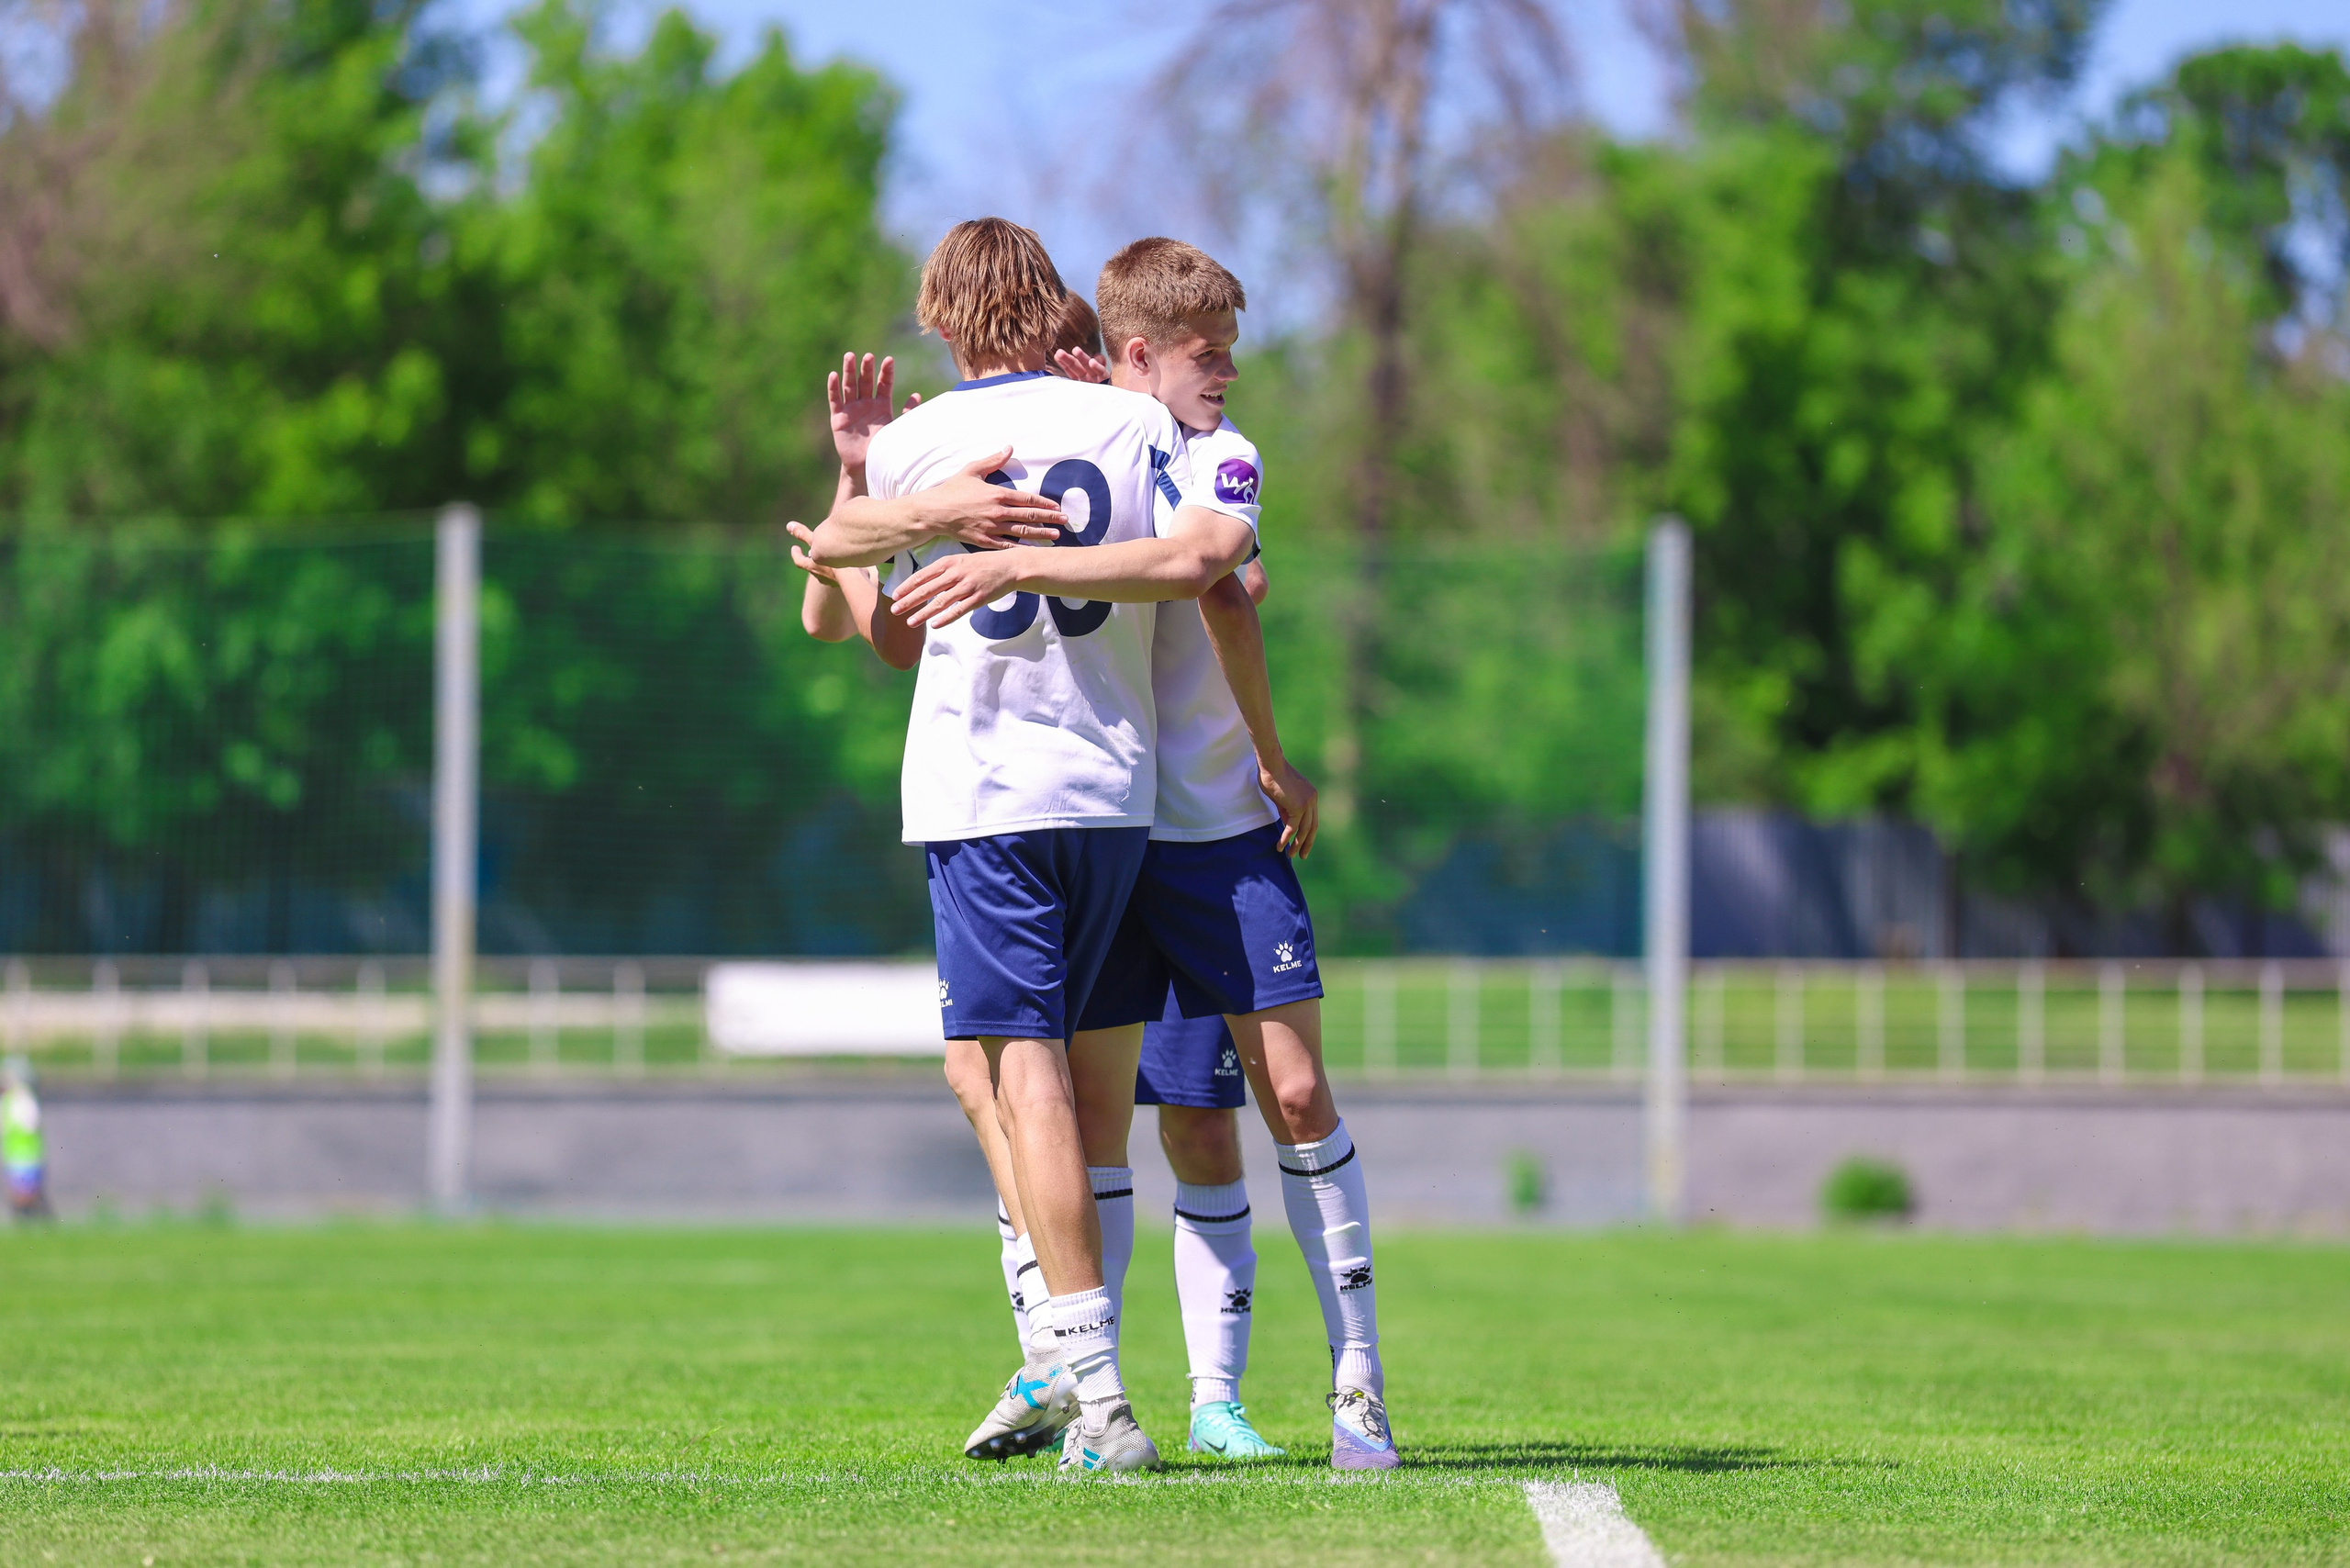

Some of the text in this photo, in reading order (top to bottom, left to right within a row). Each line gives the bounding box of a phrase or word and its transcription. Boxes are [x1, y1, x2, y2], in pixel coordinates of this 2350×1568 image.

[1273, 960, 1303, 973] KELME
[1214, 1068, 1238, 1076] KELME
[1068, 1316, 1115, 1335] KELME
